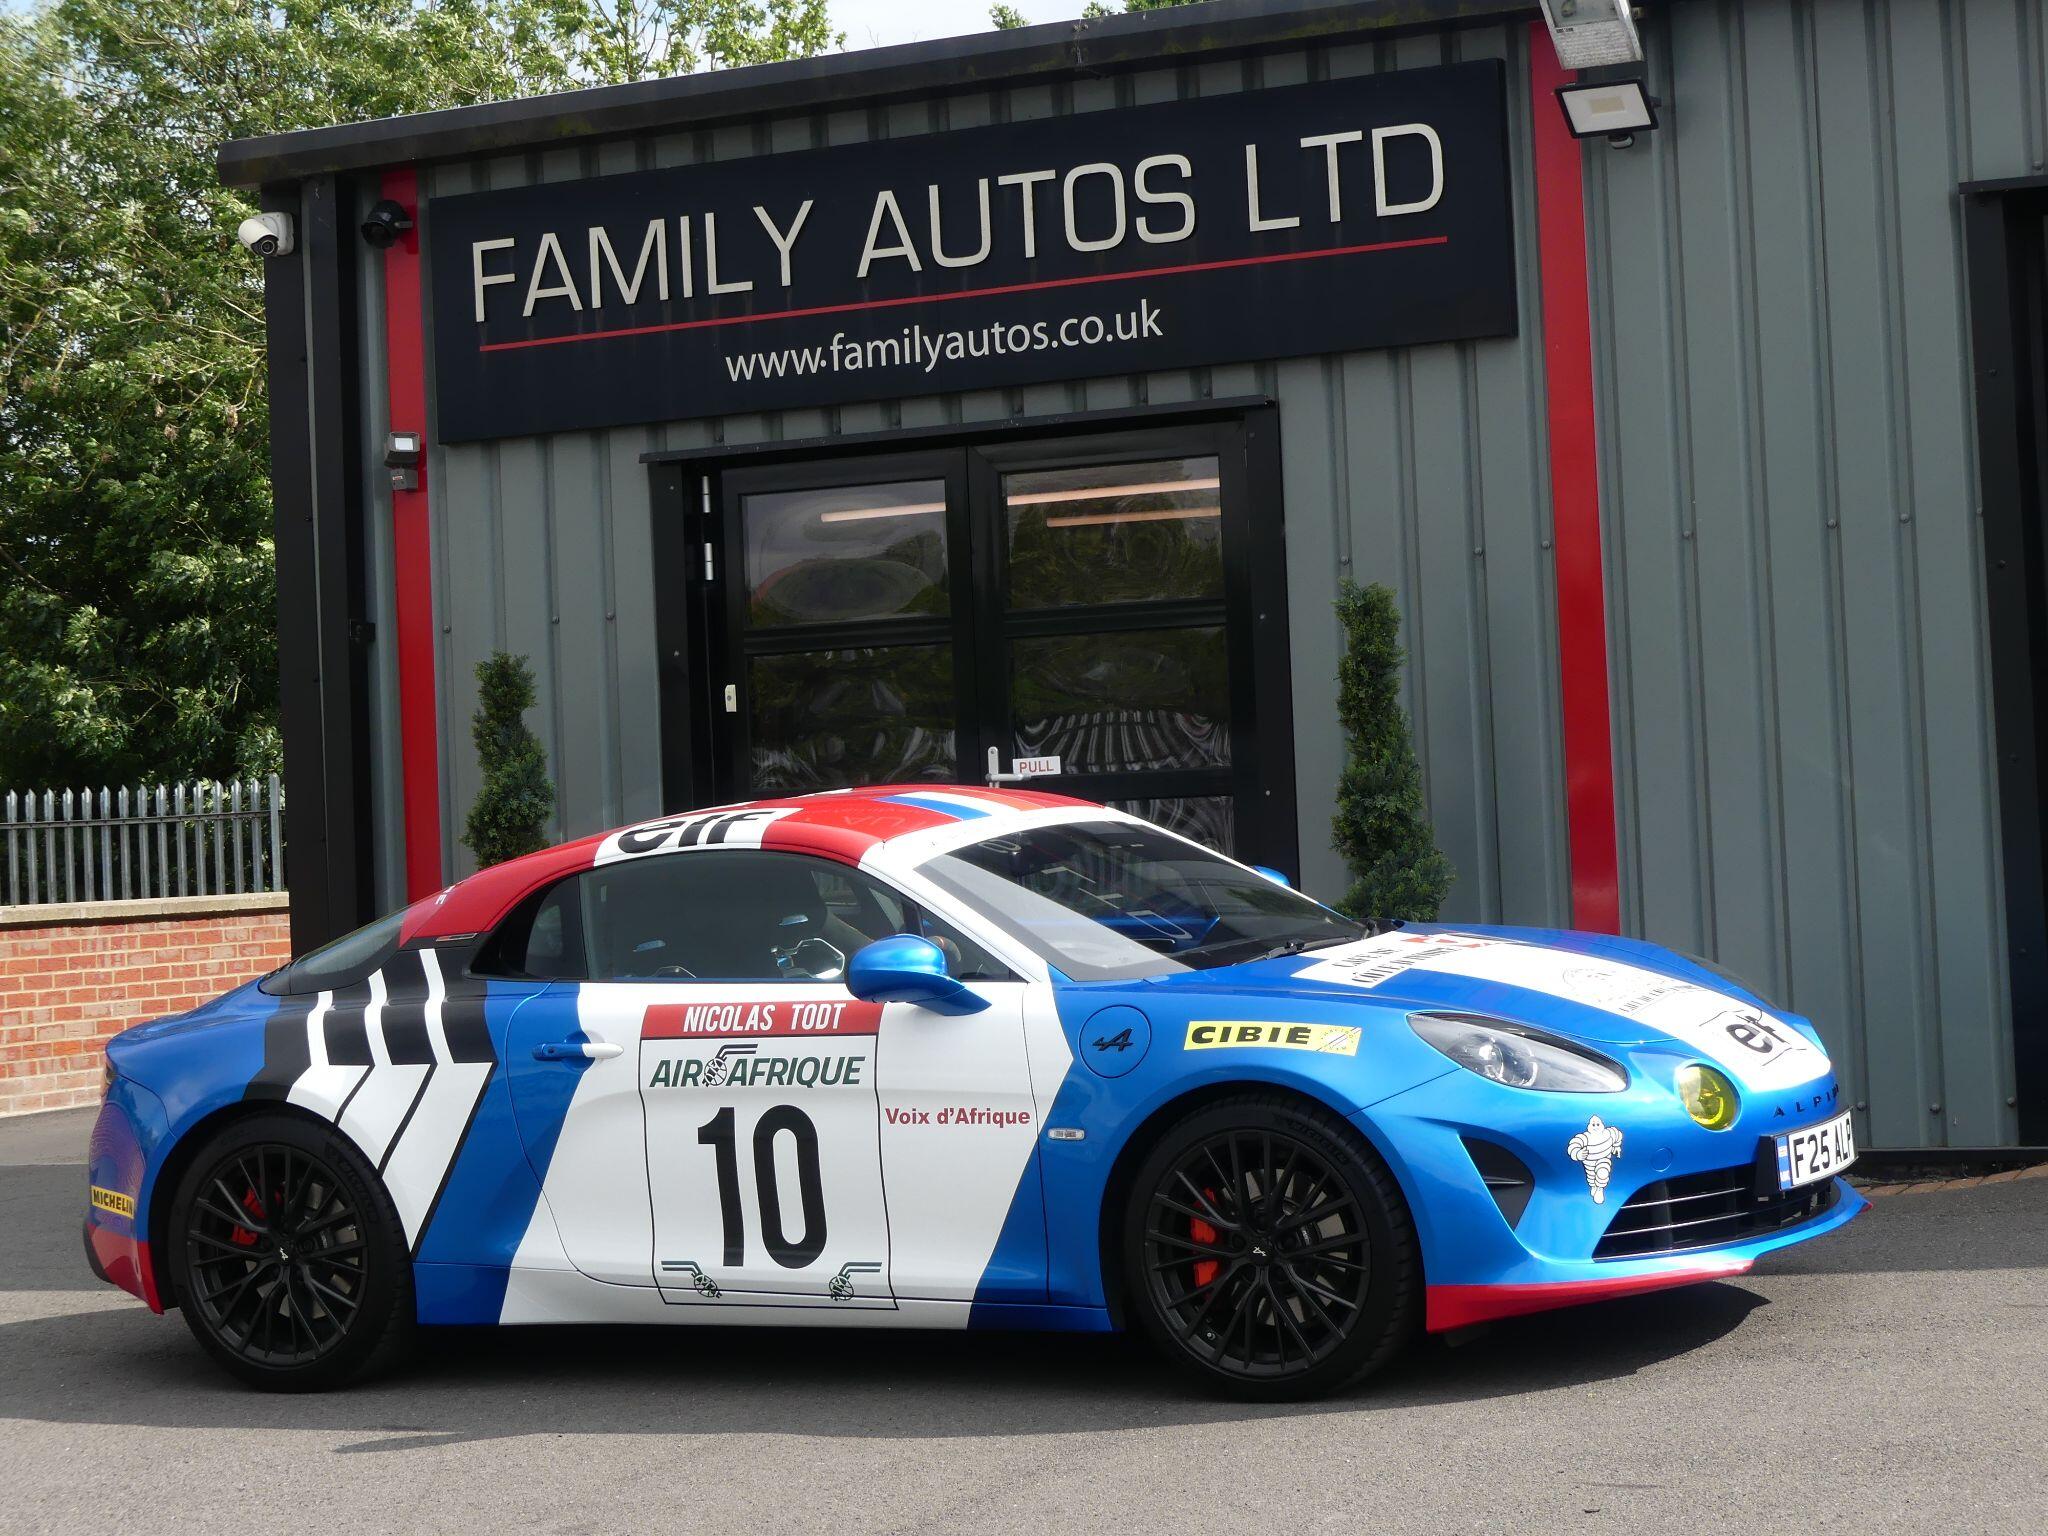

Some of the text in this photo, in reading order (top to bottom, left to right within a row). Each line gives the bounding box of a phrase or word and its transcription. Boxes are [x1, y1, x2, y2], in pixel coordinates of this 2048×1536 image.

[472, 123, 1444, 322] FAMILY AUTOS LTD
[726, 299, 1163, 382] www.familyautos.co.uk
[1019, 760, 1054, 774] PULL
[618, 811, 776, 853] elf
[683, 1003, 847, 1032] NICOLAS TODT
[649, 1056, 866, 1089] AIR AFRIQUE
[885, 1108, 930, 1124] Voix
[1793, 1118, 1851, 1178] F25 ALP
[698, 1104, 828, 1269] 10
